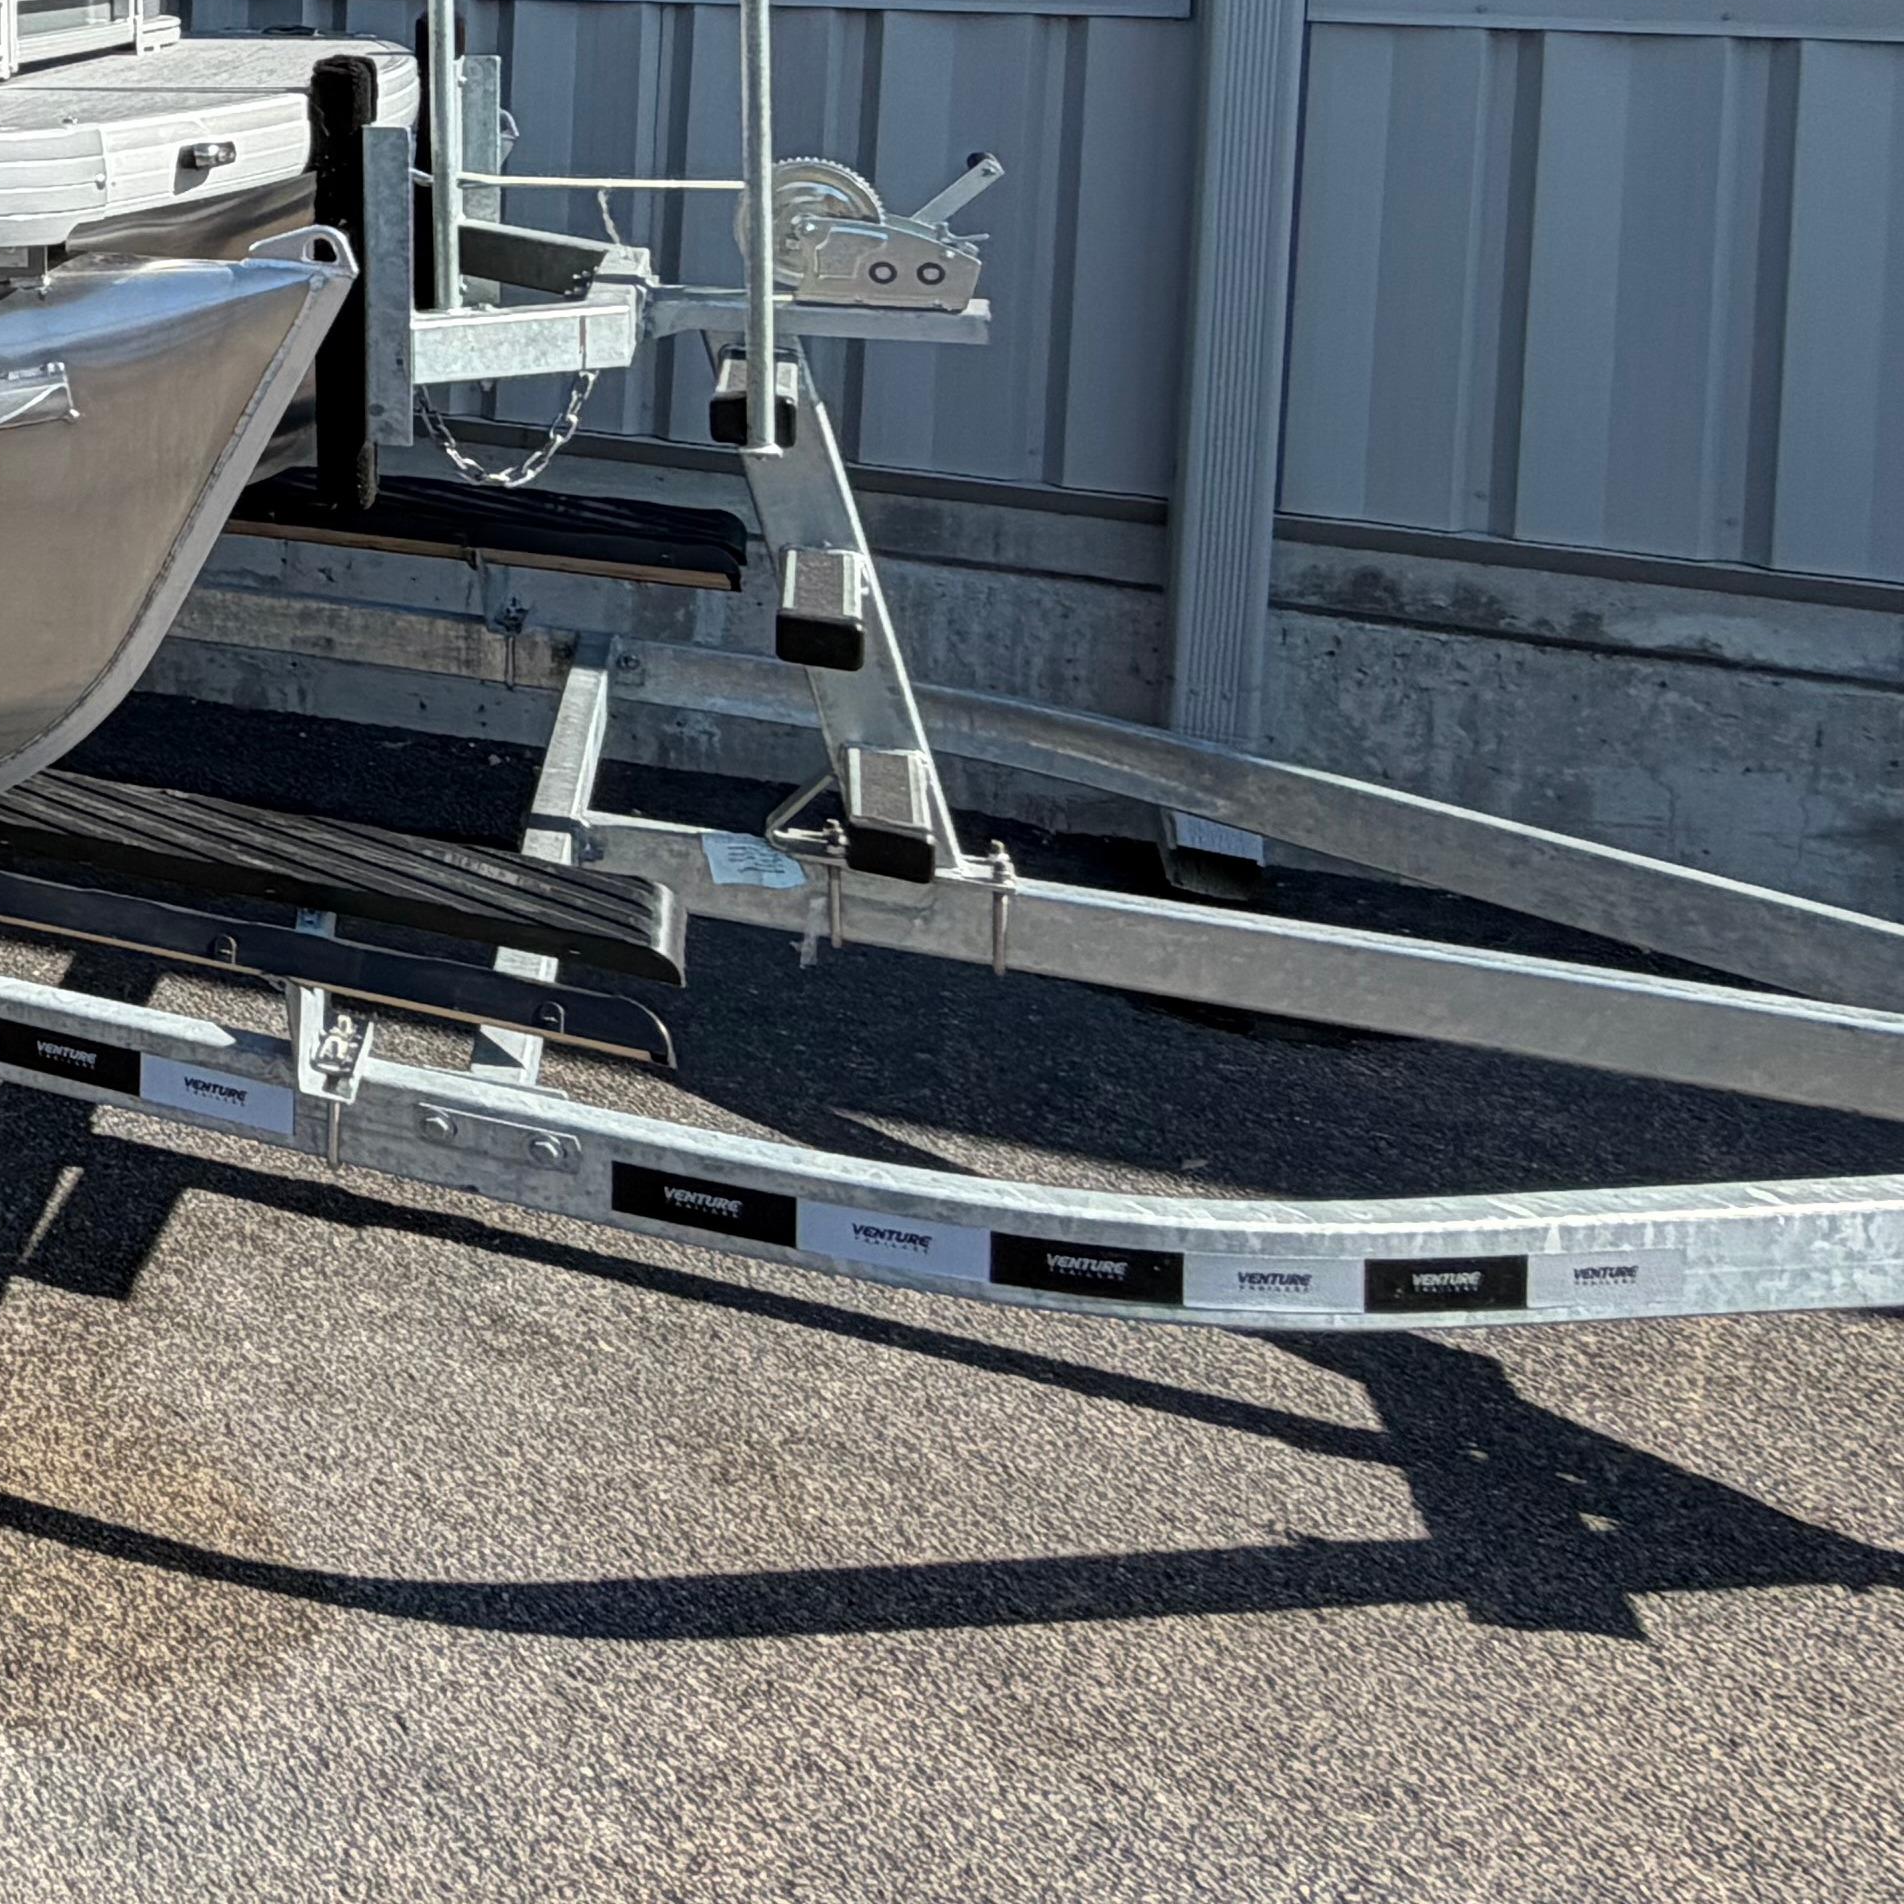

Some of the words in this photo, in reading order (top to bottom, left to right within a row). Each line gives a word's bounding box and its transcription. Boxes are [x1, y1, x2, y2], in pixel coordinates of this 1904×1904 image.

[37, 1040, 97, 1065] VENTURE
[184, 1076, 248, 1101] VENTURE
[663, 1186, 743, 1213] VENTURE
[851, 1223, 933, 1248] VENTURE
[1046, 1253, 1129, 1276] VENTURE
[1573, 1265, 1640, 1280] VENTURE
[1237, 1271, 1312, 1286] VENTURE
[1412, 1270, 1483, 1287] VENTURE
